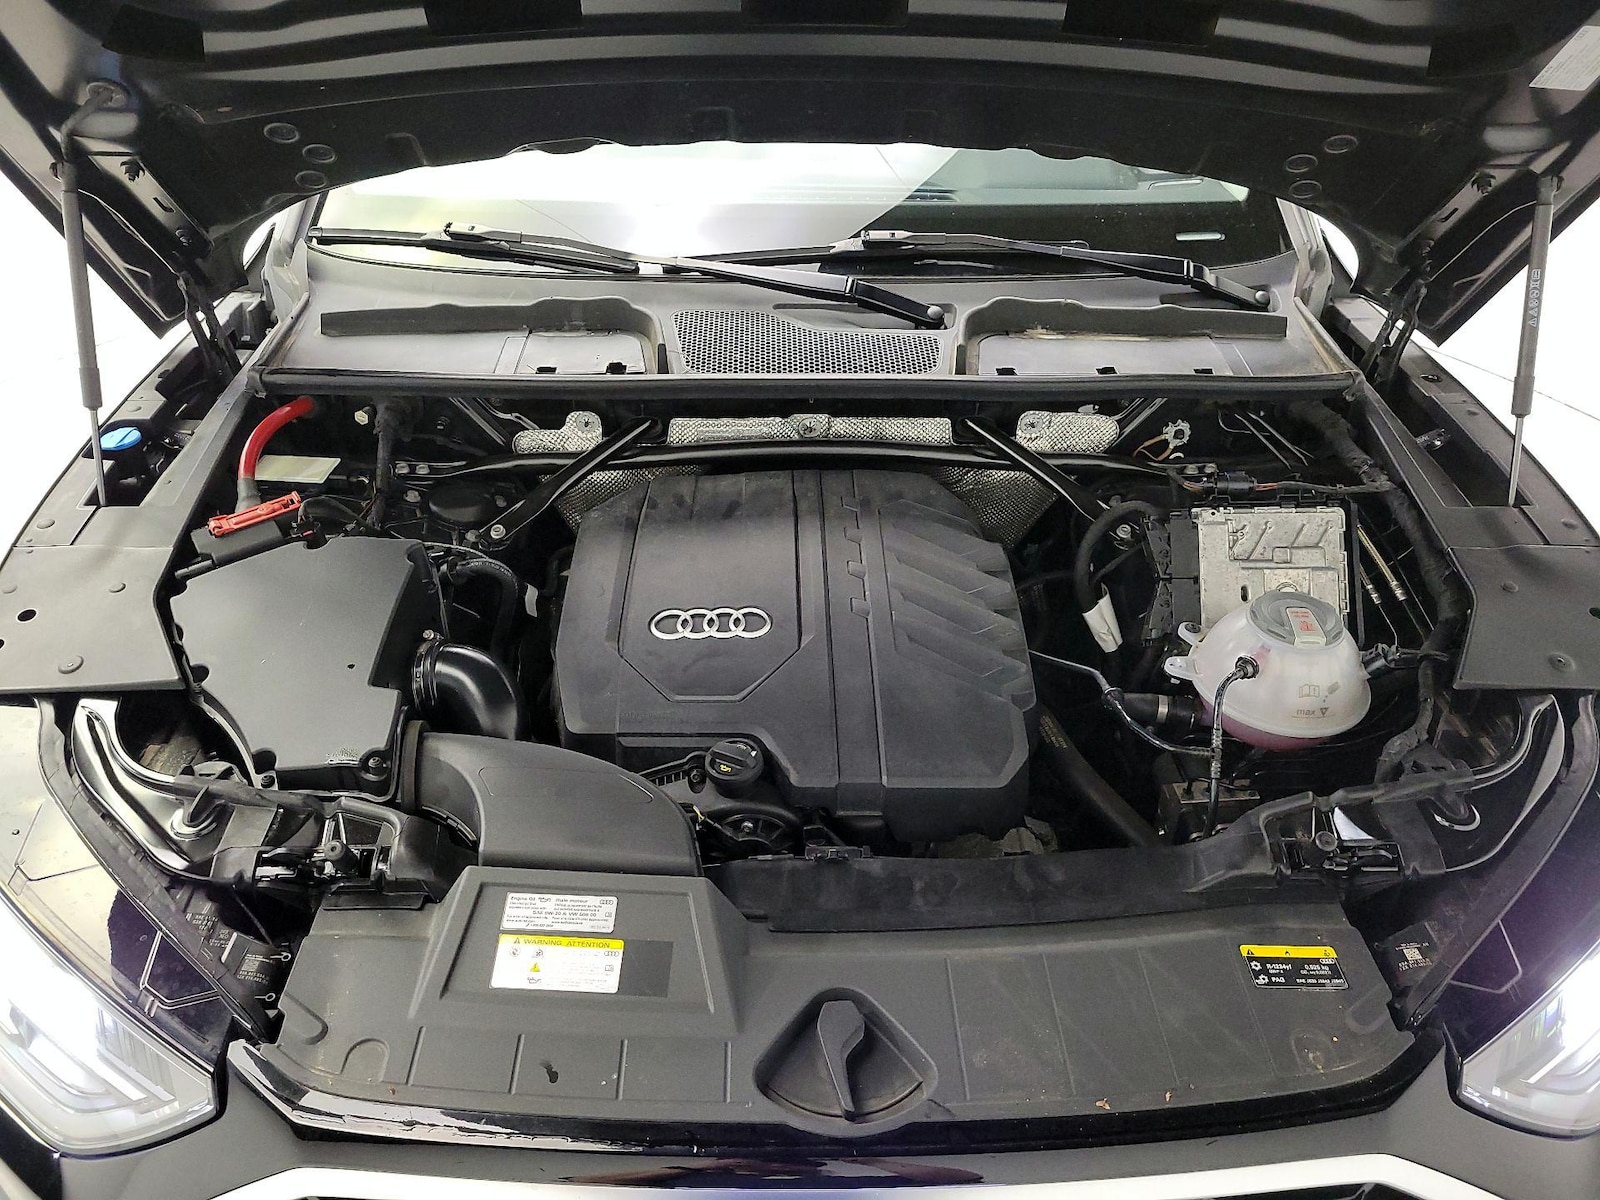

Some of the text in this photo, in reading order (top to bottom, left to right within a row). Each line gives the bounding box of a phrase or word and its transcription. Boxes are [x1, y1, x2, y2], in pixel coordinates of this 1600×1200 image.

[1296, 708, 1316, 716] max
[523, 938, 611, 949] WARNING ATTENTION
